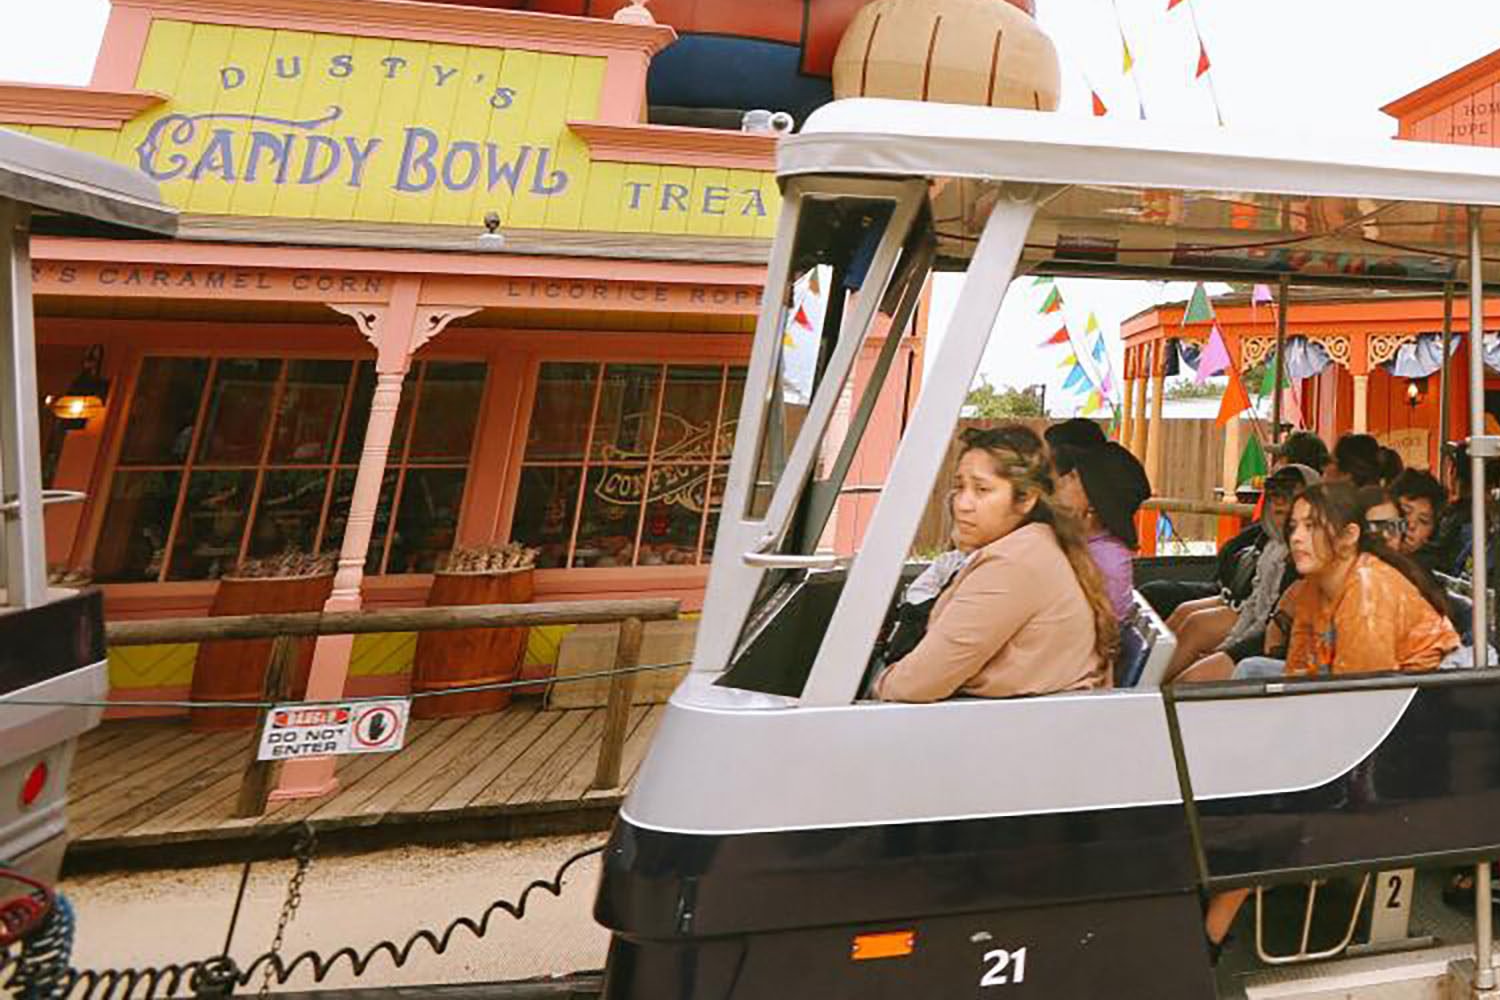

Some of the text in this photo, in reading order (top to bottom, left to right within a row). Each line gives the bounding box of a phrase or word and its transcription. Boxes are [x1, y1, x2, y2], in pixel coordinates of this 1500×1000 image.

[219, 54, 517, 109] DUSTY'S
[135, 105, 568, 197] CANDY BOWL
[99, 266, 272, 289] CARAMEL
[292, 274, 383, 294] CORN
[507, 280, 668, 302] LICORICE
[268, 728, 345, 744] DO NOT
[272, 741, 337, 757] ENTER
[1387, 875, 1402, 908] 2
[979, 946, 1027, 987] 21
